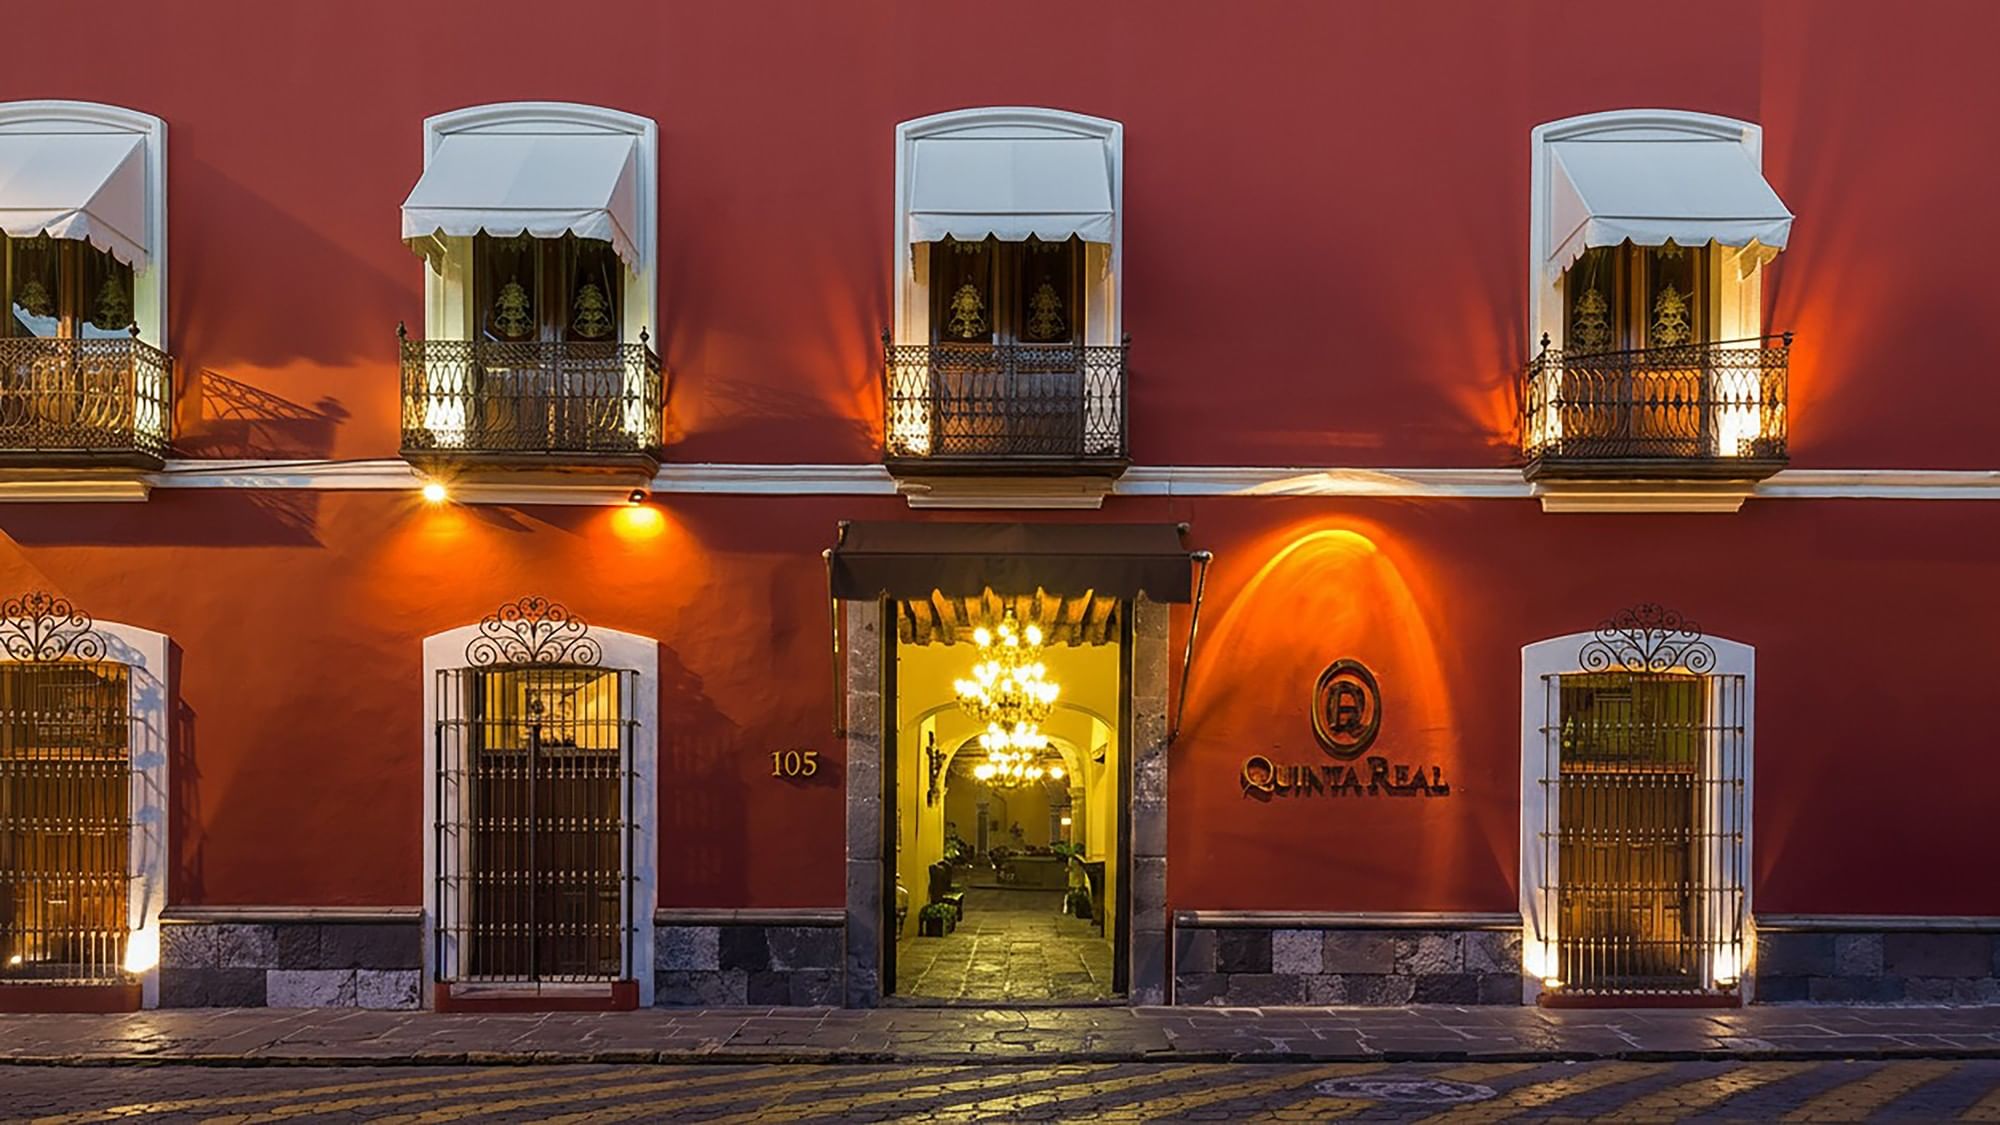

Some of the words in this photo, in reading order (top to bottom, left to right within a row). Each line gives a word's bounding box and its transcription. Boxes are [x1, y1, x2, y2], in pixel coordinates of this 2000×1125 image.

[771, 750, 818, 776] 105
[1241, 755, 1362, 799] QUINTA
[1366, 756, 1449, 797] REAL
